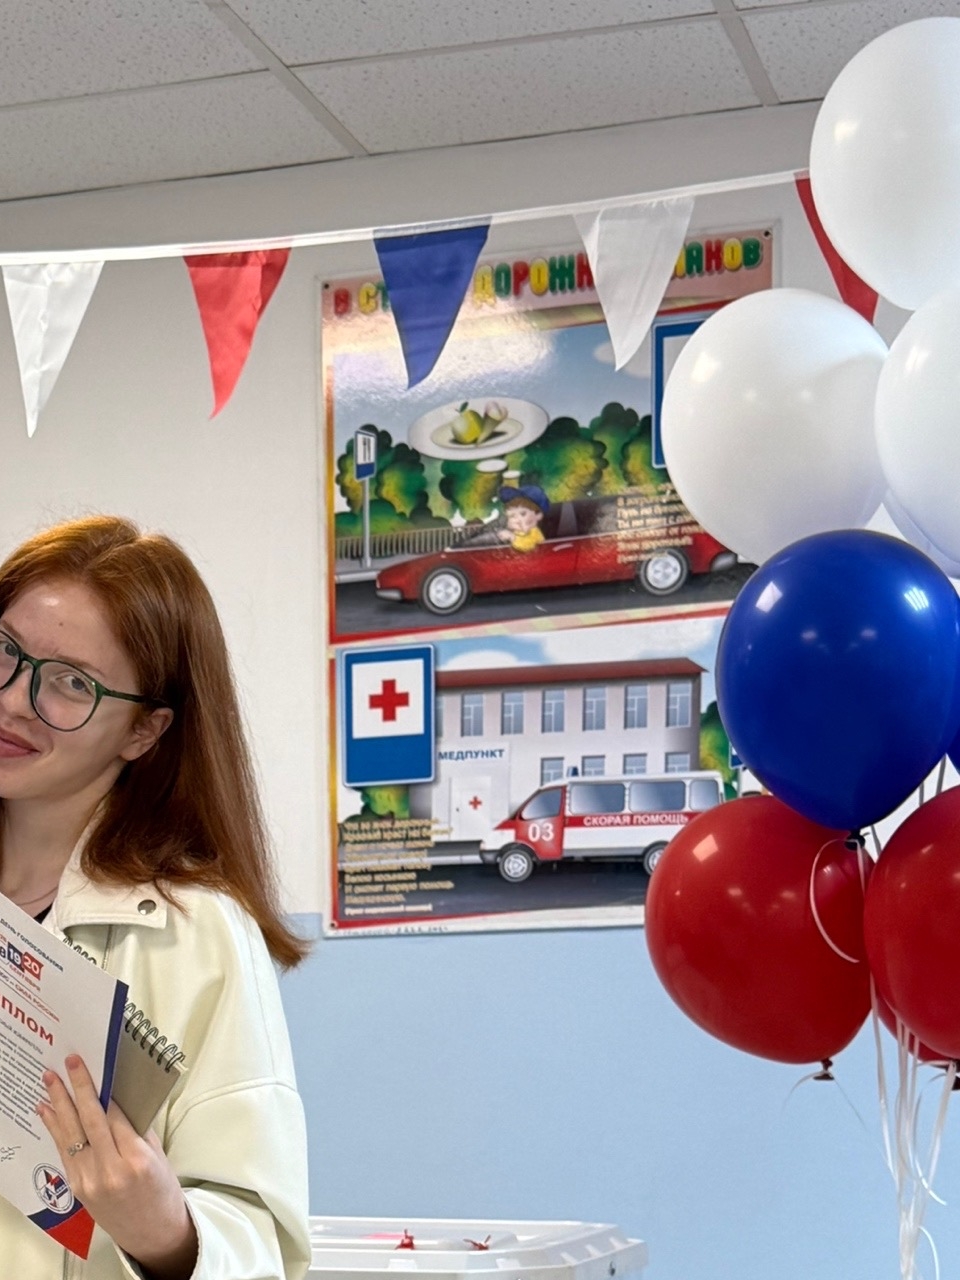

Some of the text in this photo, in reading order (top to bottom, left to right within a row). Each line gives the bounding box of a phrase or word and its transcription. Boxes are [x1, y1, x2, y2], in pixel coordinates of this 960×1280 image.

[474, 252, 595, 309] ДОРОЖН
[672, 237, 763, 280] АКОВ
[437, 748, 505, 761] МЕДПУНКТ
[583, 813, 689, 826] СКОРАЯ ПОМОЩЬ
[527, 822, 555, 843] 03
[7, 947, 22, 966] 19
[23, 955, 40, 974] 20
